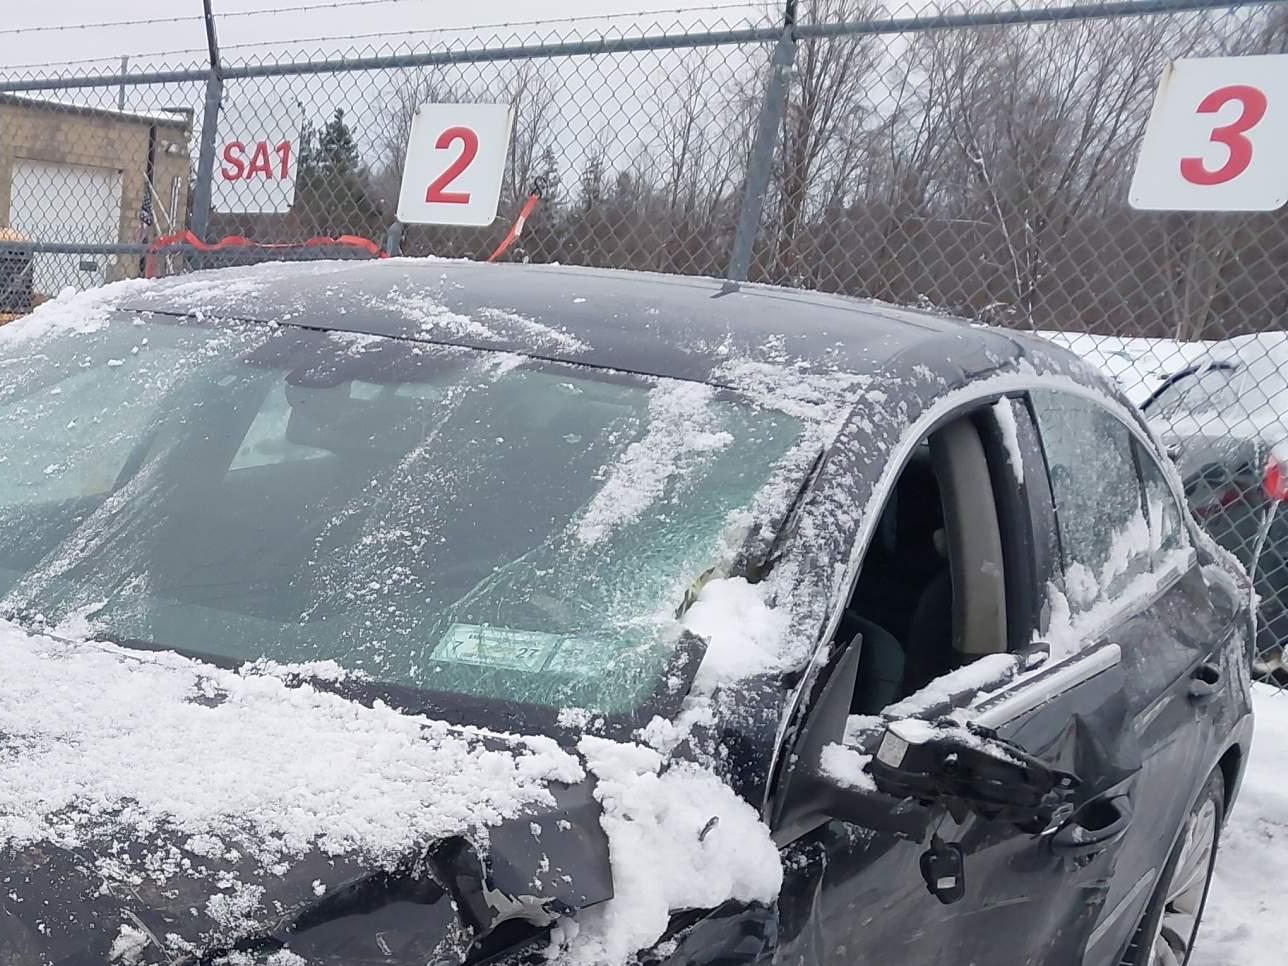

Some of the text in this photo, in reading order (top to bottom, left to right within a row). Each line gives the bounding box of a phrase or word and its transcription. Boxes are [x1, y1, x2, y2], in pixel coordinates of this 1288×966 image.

[220, 141, 292, 181] SA1
[425, 126, 479, 205] 2
[1180, 85, 1268, 186] 3
